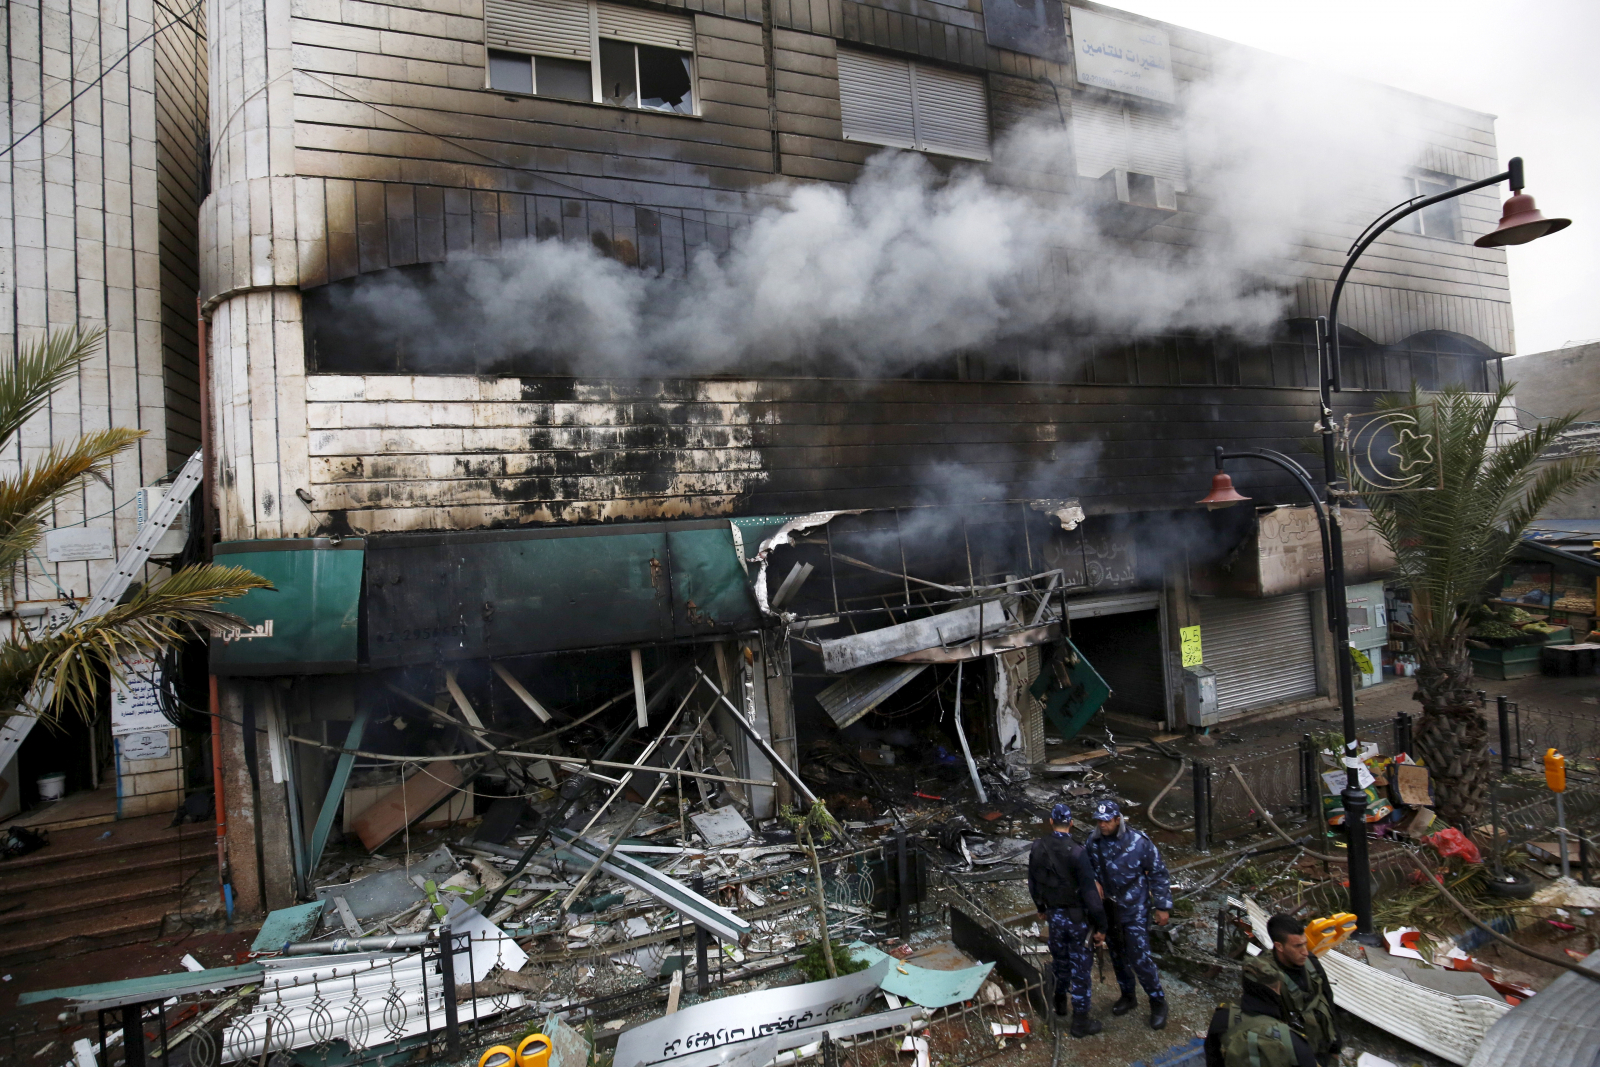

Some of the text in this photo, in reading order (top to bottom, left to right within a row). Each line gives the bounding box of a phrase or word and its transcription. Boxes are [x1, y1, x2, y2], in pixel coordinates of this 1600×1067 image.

[1082, 38, 1165, 71] شقيرات للتأمين
[1105, 566, 1135, 585] بلدية
[663, 1039, 682, 1057] بن
